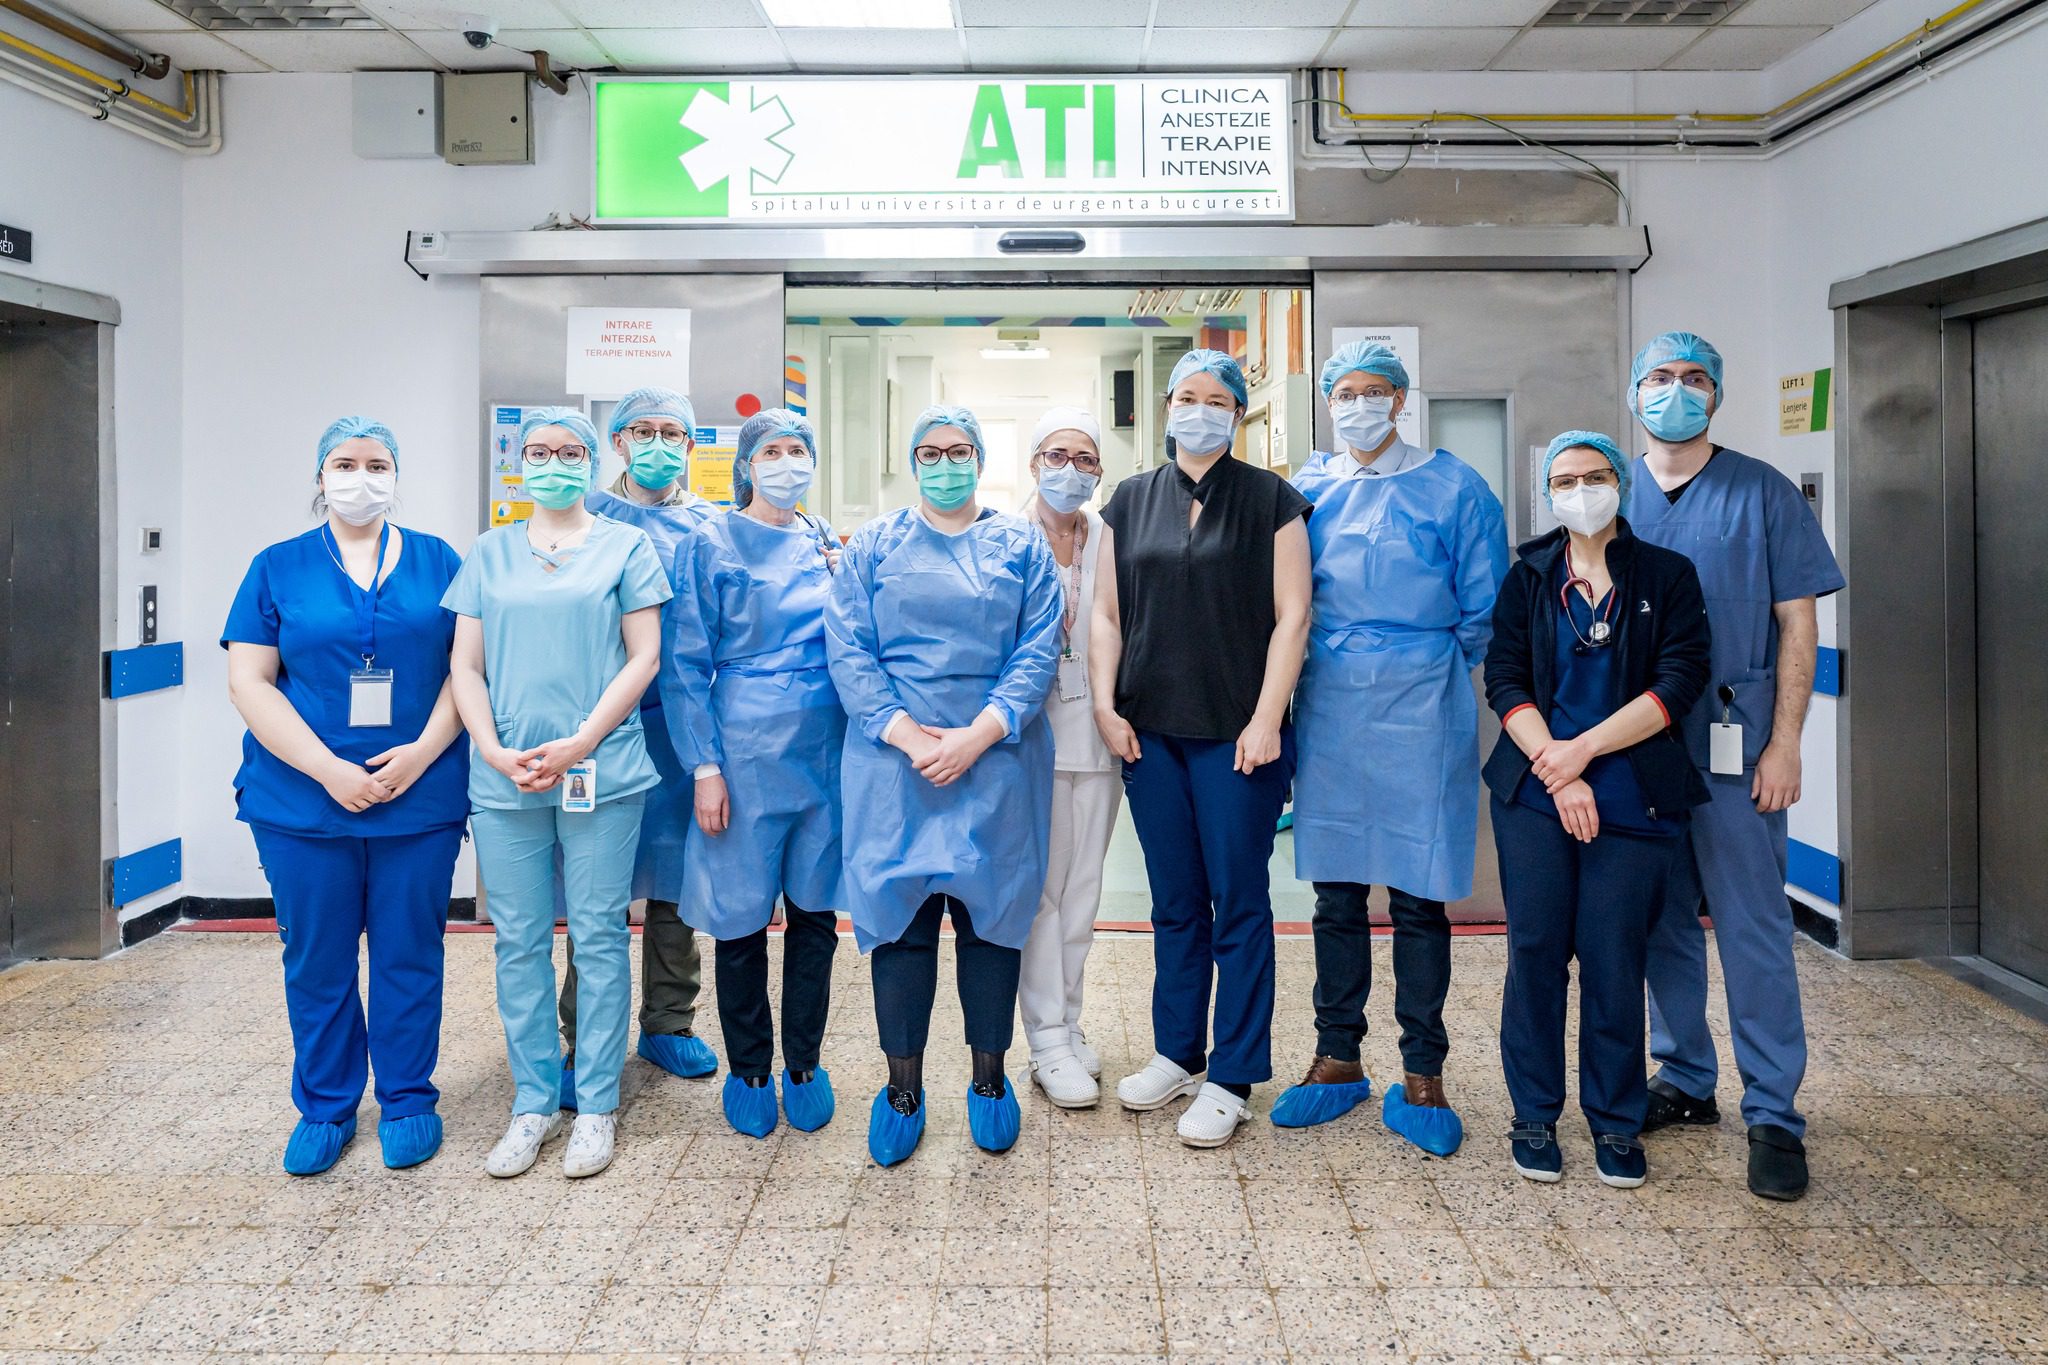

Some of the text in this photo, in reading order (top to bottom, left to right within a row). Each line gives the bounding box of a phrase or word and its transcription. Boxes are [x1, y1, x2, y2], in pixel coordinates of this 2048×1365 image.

[1160, 88, 1270, 104] CLINICA
[1160, 112, 1271, 128] ANESTEZIE
[956, 84, 1117, 179] ATI
[1160, 136, 1271, 151] TERAPIE
[1161, 160, 1271, 176] INTENSIVA
[751, 196, 1281, 213] spitalul universitar de urgenta bucuresti
[605, 320, 653, 330] INTRARE
[601, 334, 657, 343] INTERZISA
[585, 349, 672, 358] TERAPIE INTENSIVA
[1782, 377, 1805, 390] LIFT 1
[1783, 401, 1807, 415] Lenjerie
